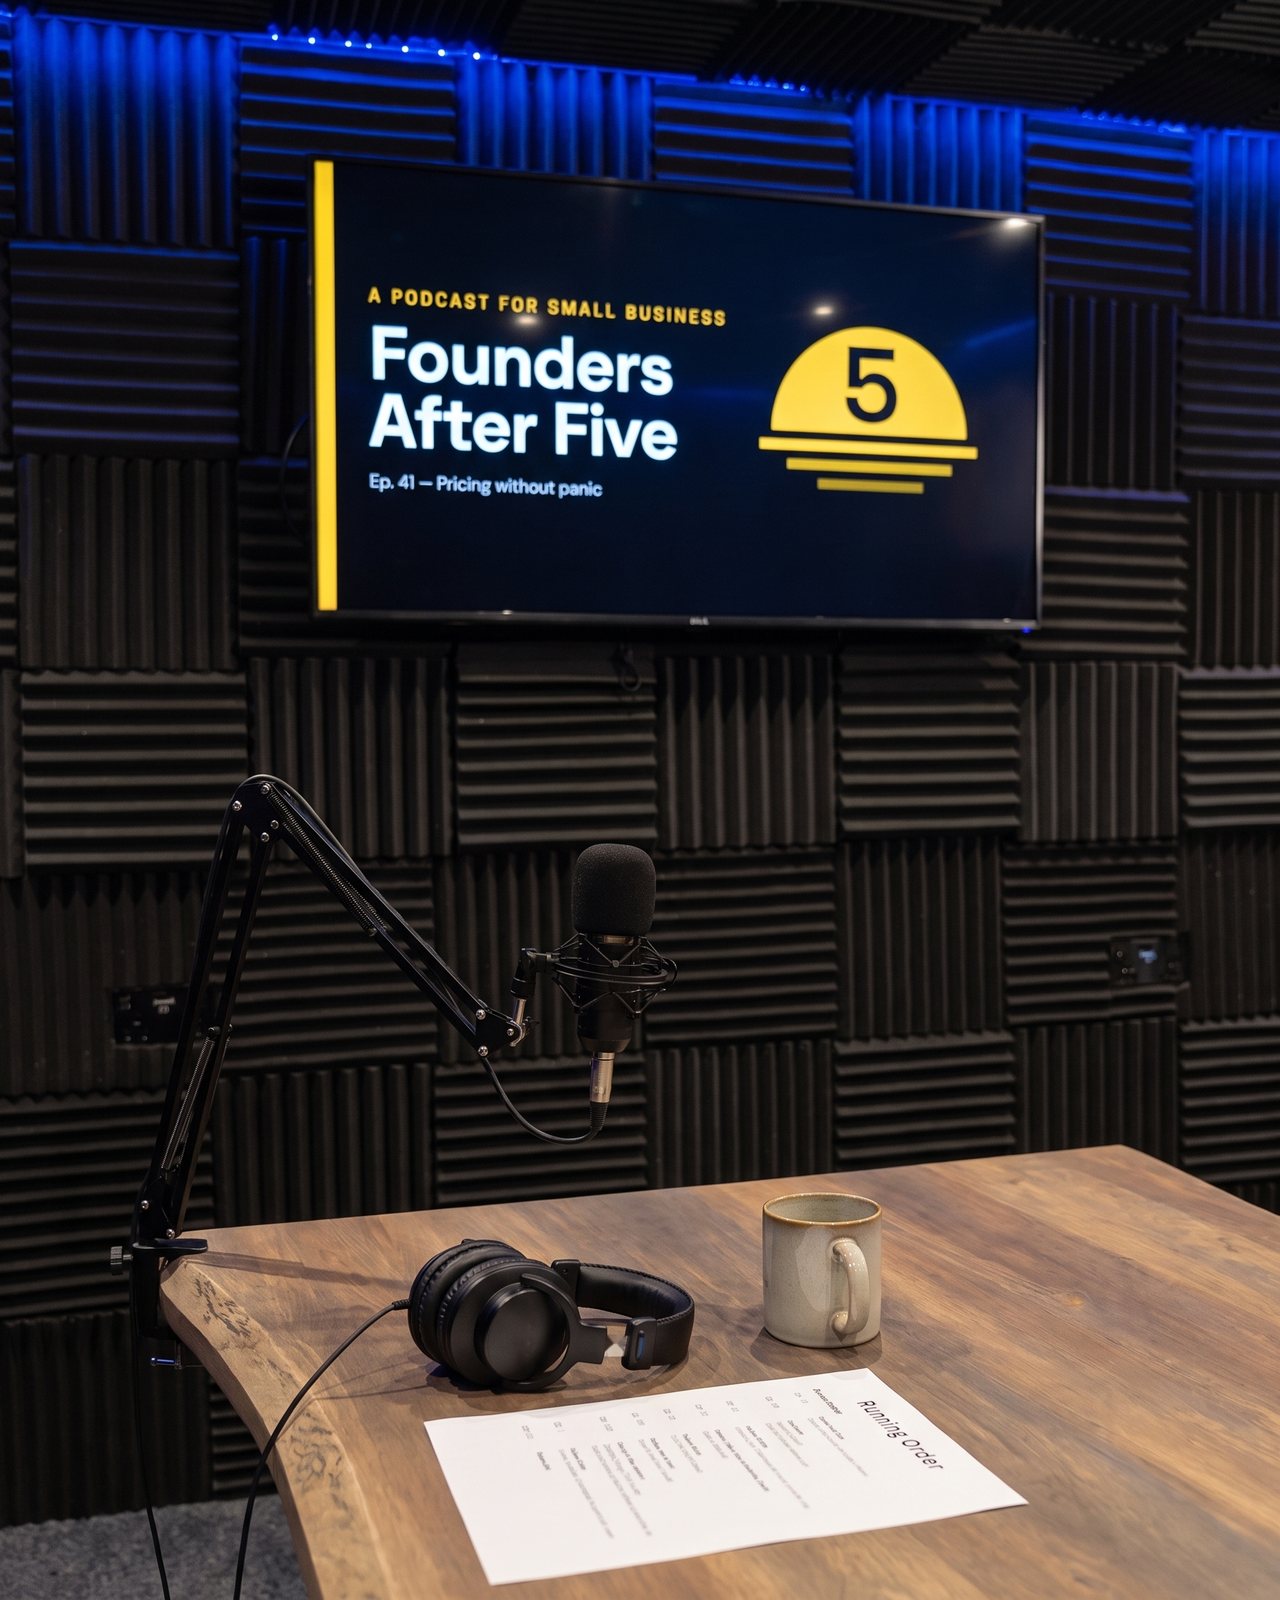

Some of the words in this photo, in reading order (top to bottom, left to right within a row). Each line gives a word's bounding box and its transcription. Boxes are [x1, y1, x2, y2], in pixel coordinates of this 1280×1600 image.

[367, 286, 381, 304] A
[391, 287, 490, 311] PODCAST
[498, 295, 539, 315] FOR
[547, 298, 616, 319] SMALL
[625, 303, 726, 327] BUSINESS
[371, 324, 674, 397] Founders
[846, 346, 897, 423] 5
[368, 391, 539, 454] After
[554, 400, 679, 461] Five
[368, 472, 395, 493] Ep.
[397, 473, 415, 491] 41
[436, 474, 493, 497] Pricing
[494, 477, 557, 496] without
[557, 480, 604, 500] panic
[857, 1400, 908, 1439] Running
[902, 1439, 944, 1469] Order
